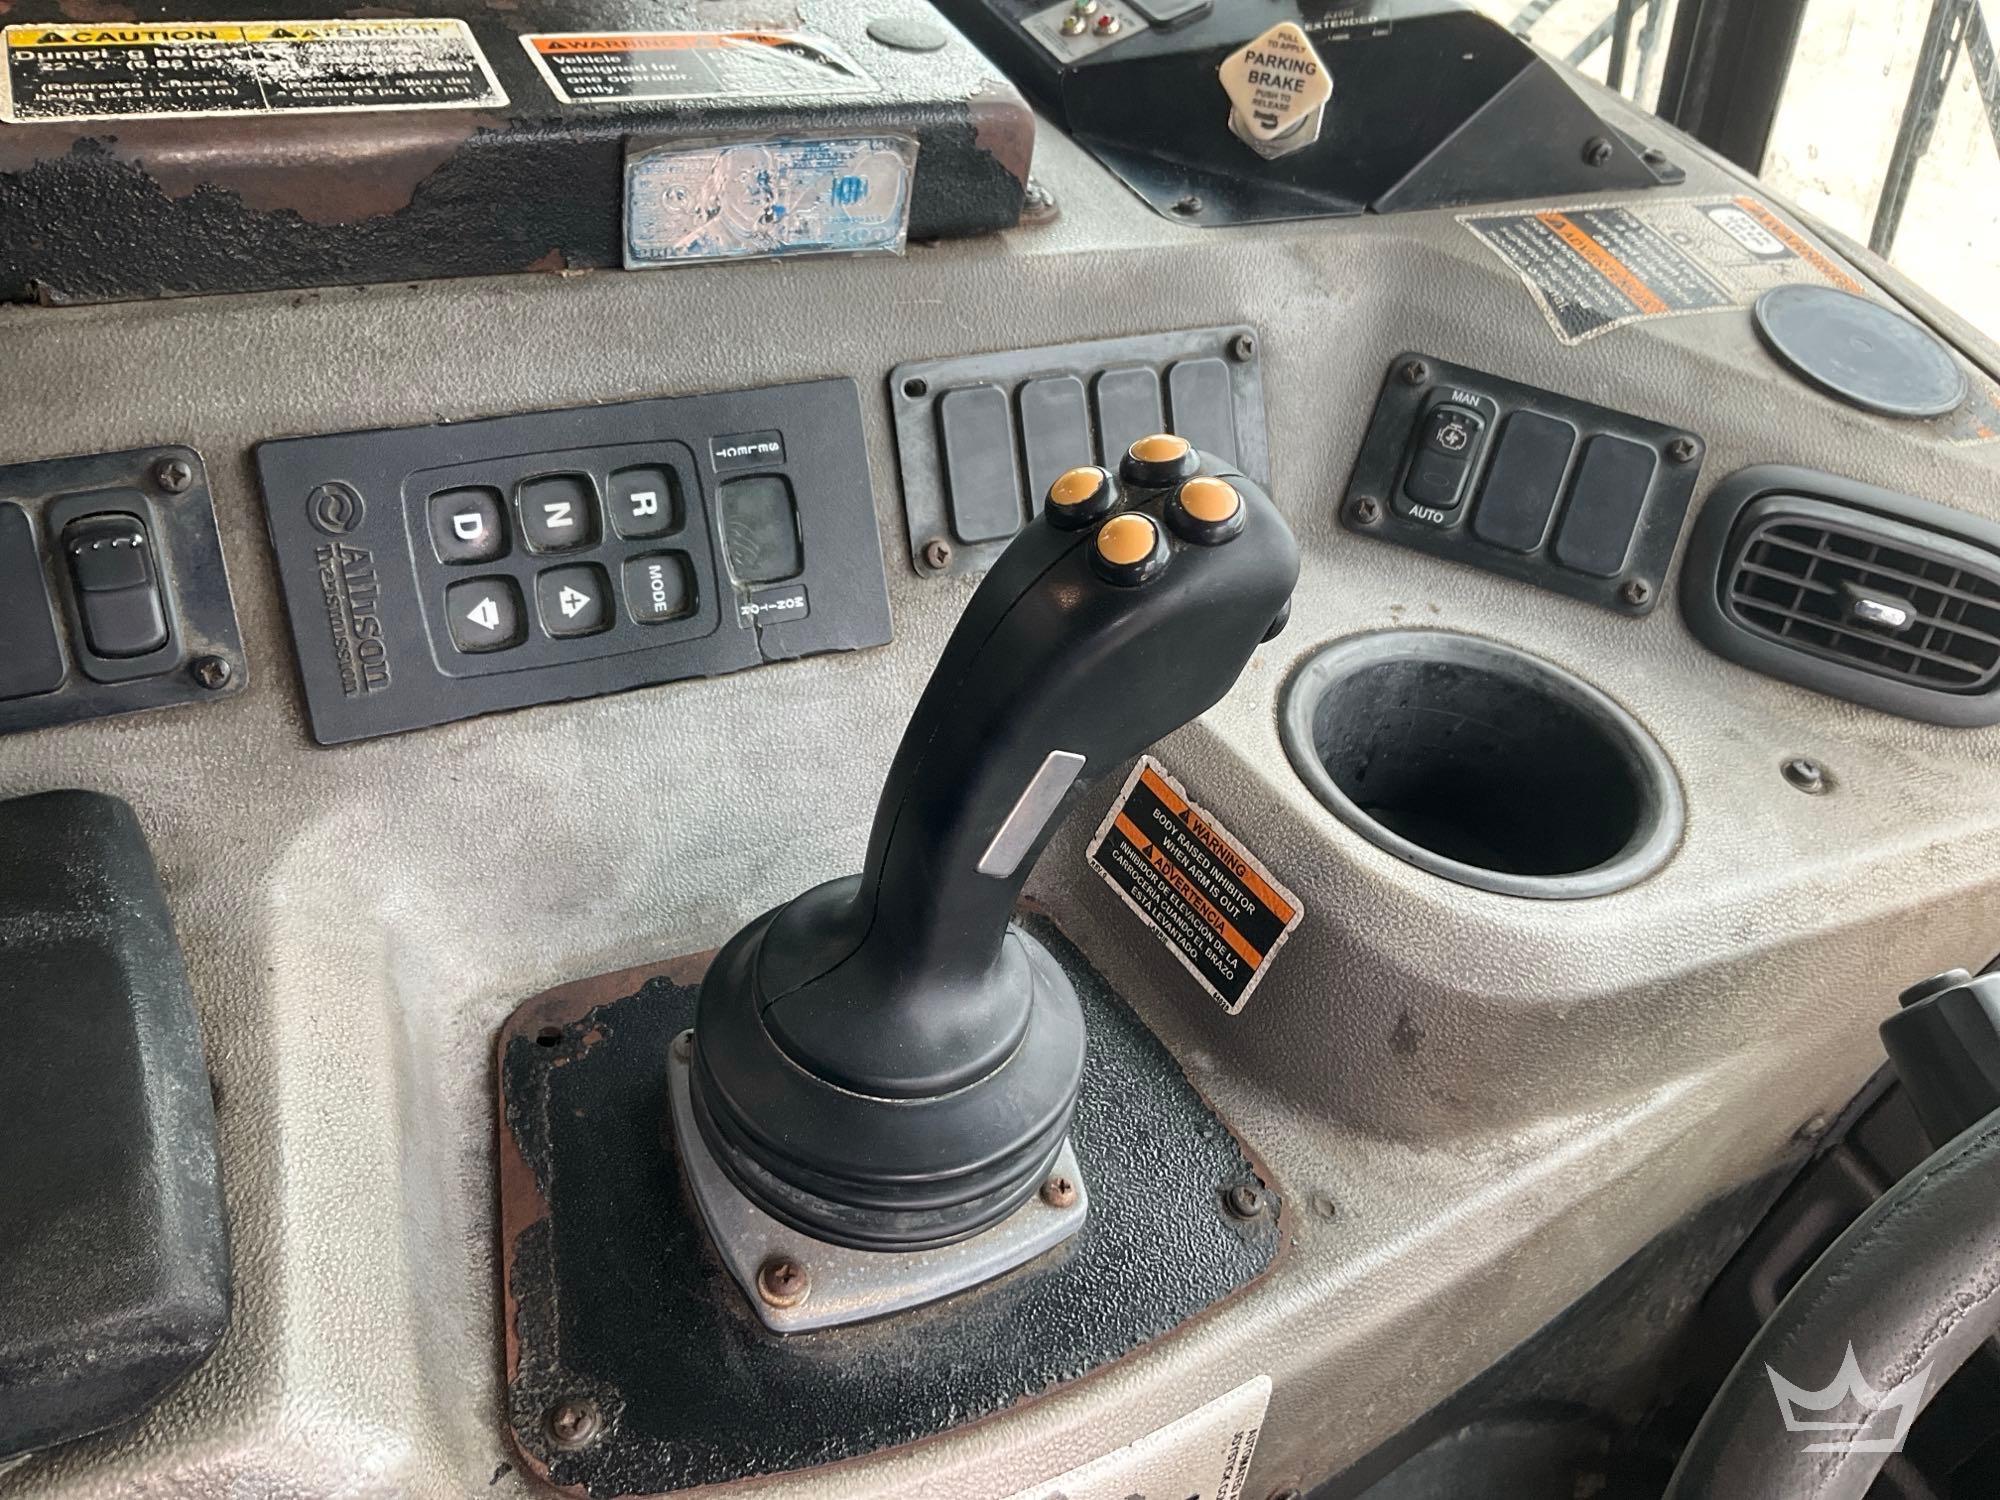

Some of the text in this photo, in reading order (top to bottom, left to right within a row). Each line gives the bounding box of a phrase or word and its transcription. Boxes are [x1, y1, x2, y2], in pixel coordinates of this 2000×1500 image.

[1305, 15, 1378, 32] EXTENDED
[71, 31, 217, 42] CAUTION
[568, 40, 678, 50] WARNING
[1268, 39, 1307, 53] TO APPLY
[1278, 32, 1298, 41] PULL
[15, 48, 144, 61] Dumpig
[552, 55, 621, 65] Vehicle
[1244, 50, 1317, 76] PARKING
[560, 63, 678, 75] designed for
[567, 73, 693, 84] one operator.
[573, 85, 620, 94] only.
[1248, 70, 1306, 93] BRAKE
[1252, 98, 1290, 112] RELEASE
[1255, 89, 1291, 102] PUSH TO
[1451, 390, 1479, 407] MAN
[716, 441, 780, 458] SELECT
[544, 502, 573, 528] N
[630, 491, 658, 517] R
[1409, 504, 1444, 524] AUTO
[453, 512, 483, 540] D
[648, 564, 667, 613] MODE
[741, 596, 805, 616] MONITOR
[316, 545, 359, 696] Transmission
[340, 543, 391, 693] Allison
[1190, 819, 1247, 878] WARNING
[1151, 807, 1256, 916] BODY RAISED INHIBITOR
[1161, 835, 1241, 920] WHEN ARM IS OUT.
[1118, 840, 1239, 969] INHIBIDOR DE ELEVACIÓN DE LA
[1153, 855, 1227, 934] ADVERTENCIA
[1110, 847, 1235, 982] CARROCERÍA CUANDO EL BRAZO
[1130, 884, 1200, 961] ESTÁ LEVANTADO.
[1220, 1430, 1244, 1486] JOYSTICK
[1230, 1429, 1258, 1493] AUTOMATED
